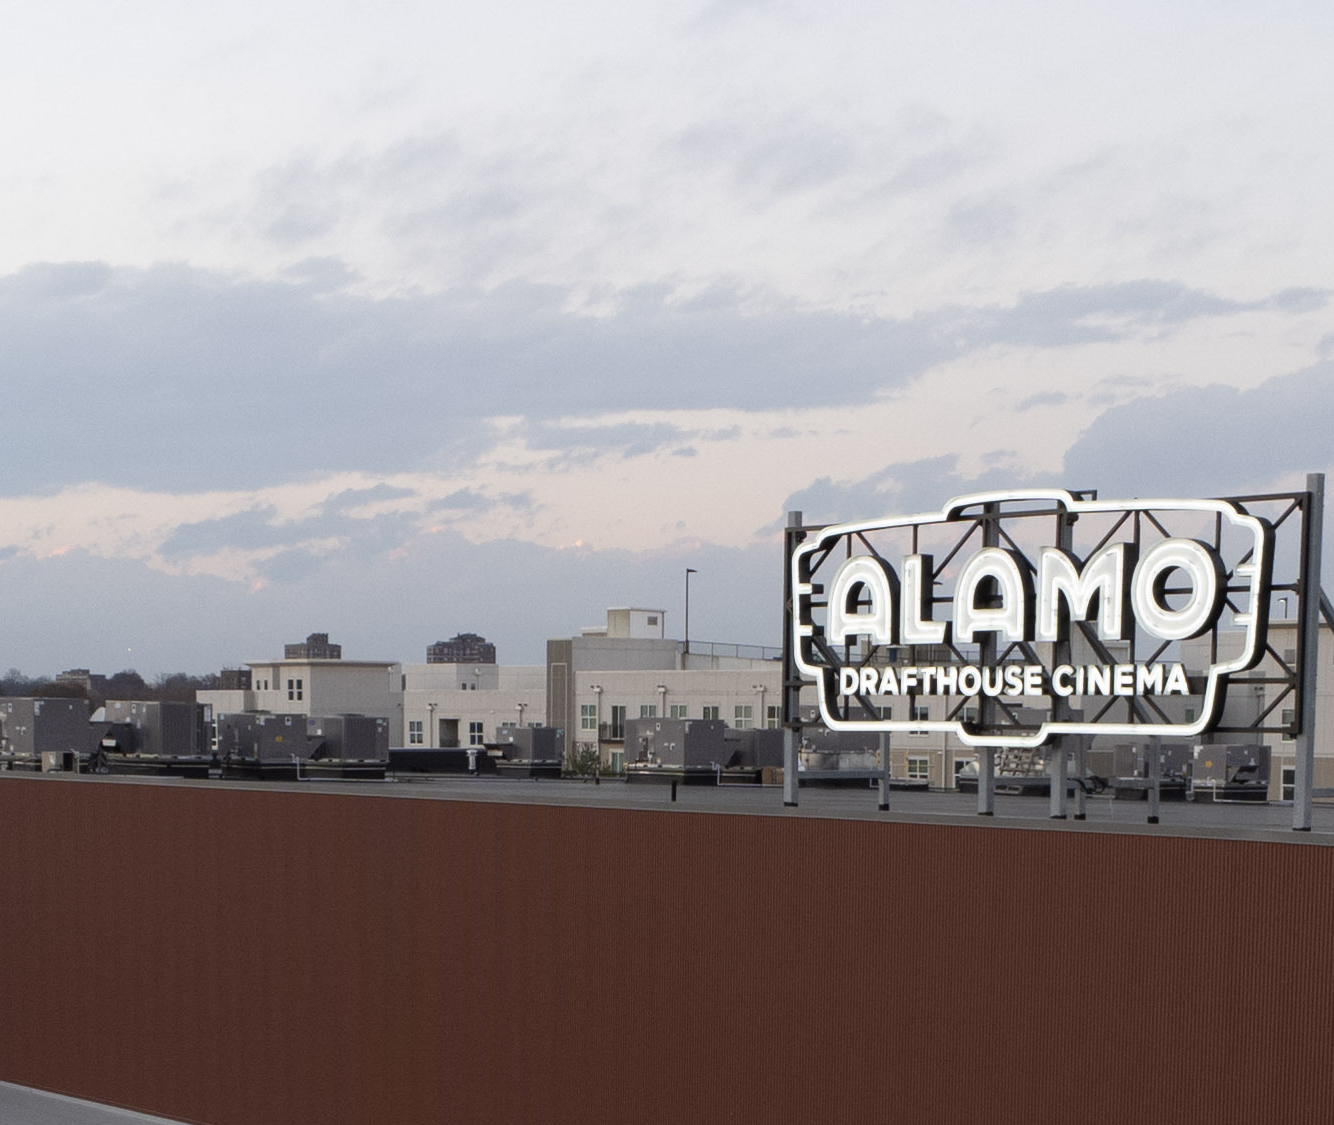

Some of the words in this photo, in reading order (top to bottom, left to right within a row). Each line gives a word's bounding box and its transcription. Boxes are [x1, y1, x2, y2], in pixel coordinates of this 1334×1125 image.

[827, 538, 1217, 646] ALAMO
[839, 665, 1043, 697] DRAFTHOUSE
[1052, 663, 1189, 696] CINEMA
